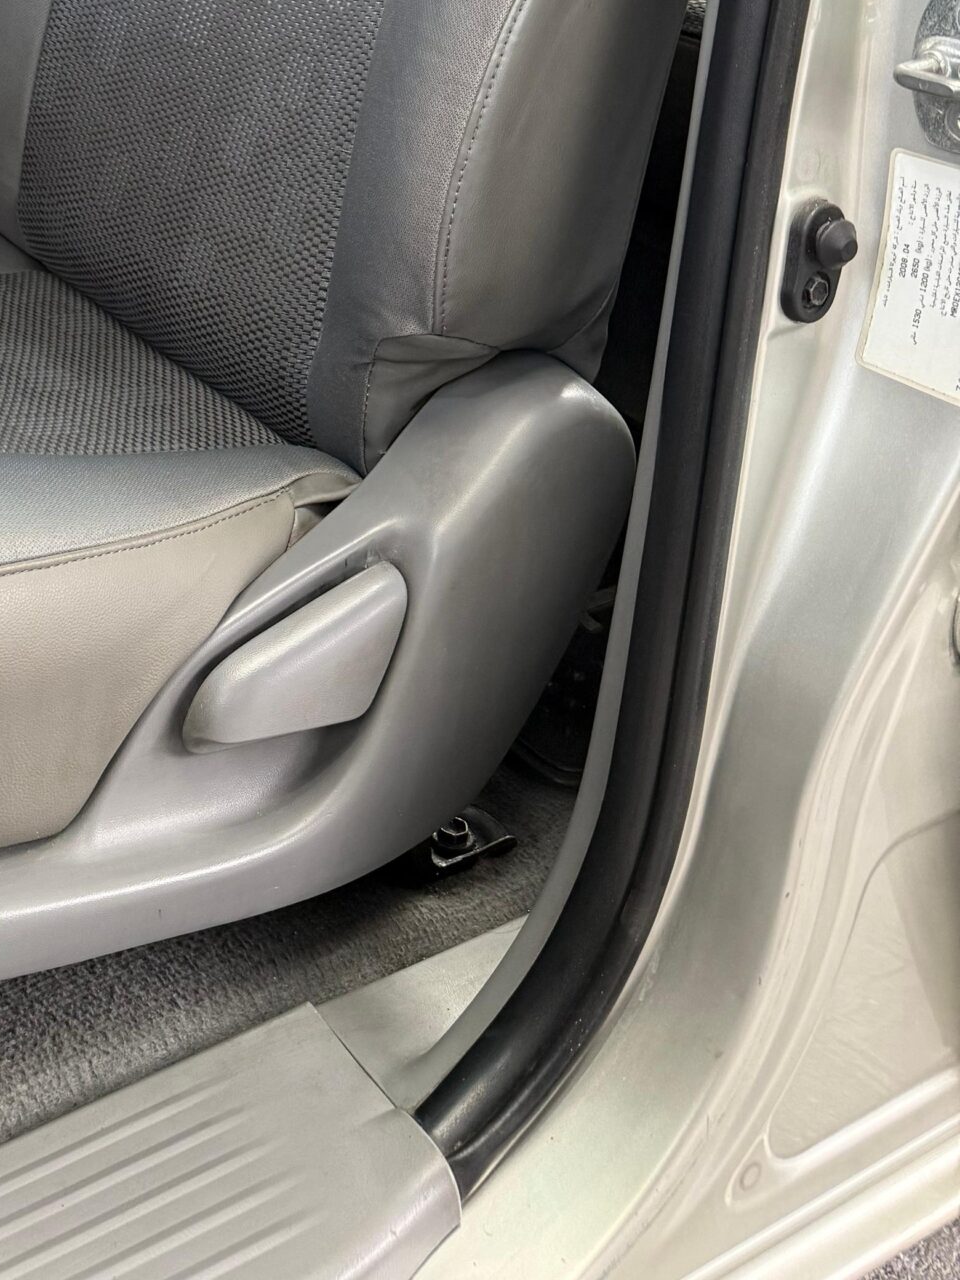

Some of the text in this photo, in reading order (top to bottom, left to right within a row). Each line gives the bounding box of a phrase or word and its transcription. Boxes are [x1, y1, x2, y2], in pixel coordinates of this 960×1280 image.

[910, 258, 921, 279] 2650
[919, 273, 930, 293] 1200
[911, 308, 922, 329] 1530
